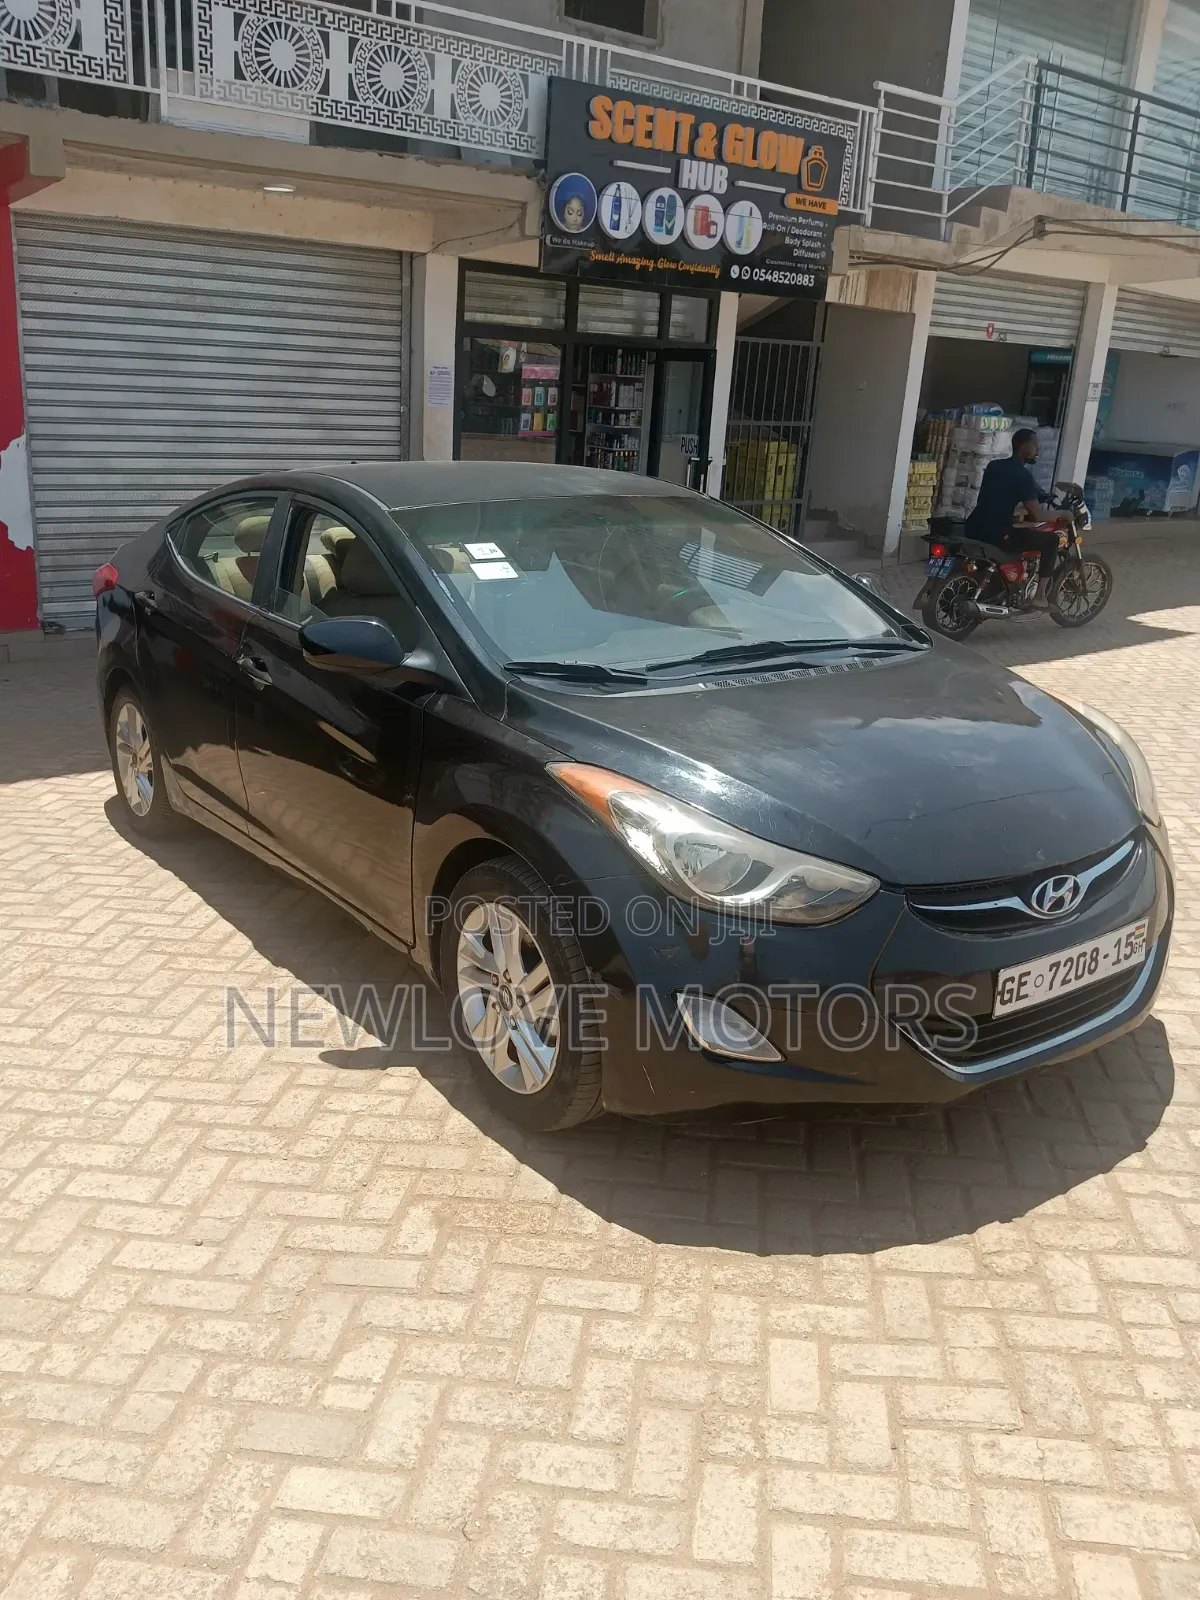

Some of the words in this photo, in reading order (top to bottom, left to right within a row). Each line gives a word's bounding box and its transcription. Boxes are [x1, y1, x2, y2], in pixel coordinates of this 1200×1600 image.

[588, 95, 695, 155] SCENT
[697, 121, 717, 160] &
[722, 123, 805, 176] GLOW
[678, 158, 729, 195] HUB
[795, 197, 808, 208] WE
[808, 198, 827, 210] HAVE
[768, 212, 798, 224] Premium
[797, 216, 824, 228] Perfume
[762, 222, 786, 233] Roll-On
[791, 226, 823, 239] Deodorant
[572, 238, 596, 248] Makeup
[785, 236, 801, 248] Body
[801, 238, 821, 249] Splash
[793, 249, 820, 259] Diffusers
[589, 250, 616, 262] Smell
[657, 258, 678, 269] Glow
[678, 260, 721, 279] Confidently
[752, 270, 815, 287] 0548520883
[680, 436, 700, 455] PUSH
[999, 970, 1031, 1006] GE
